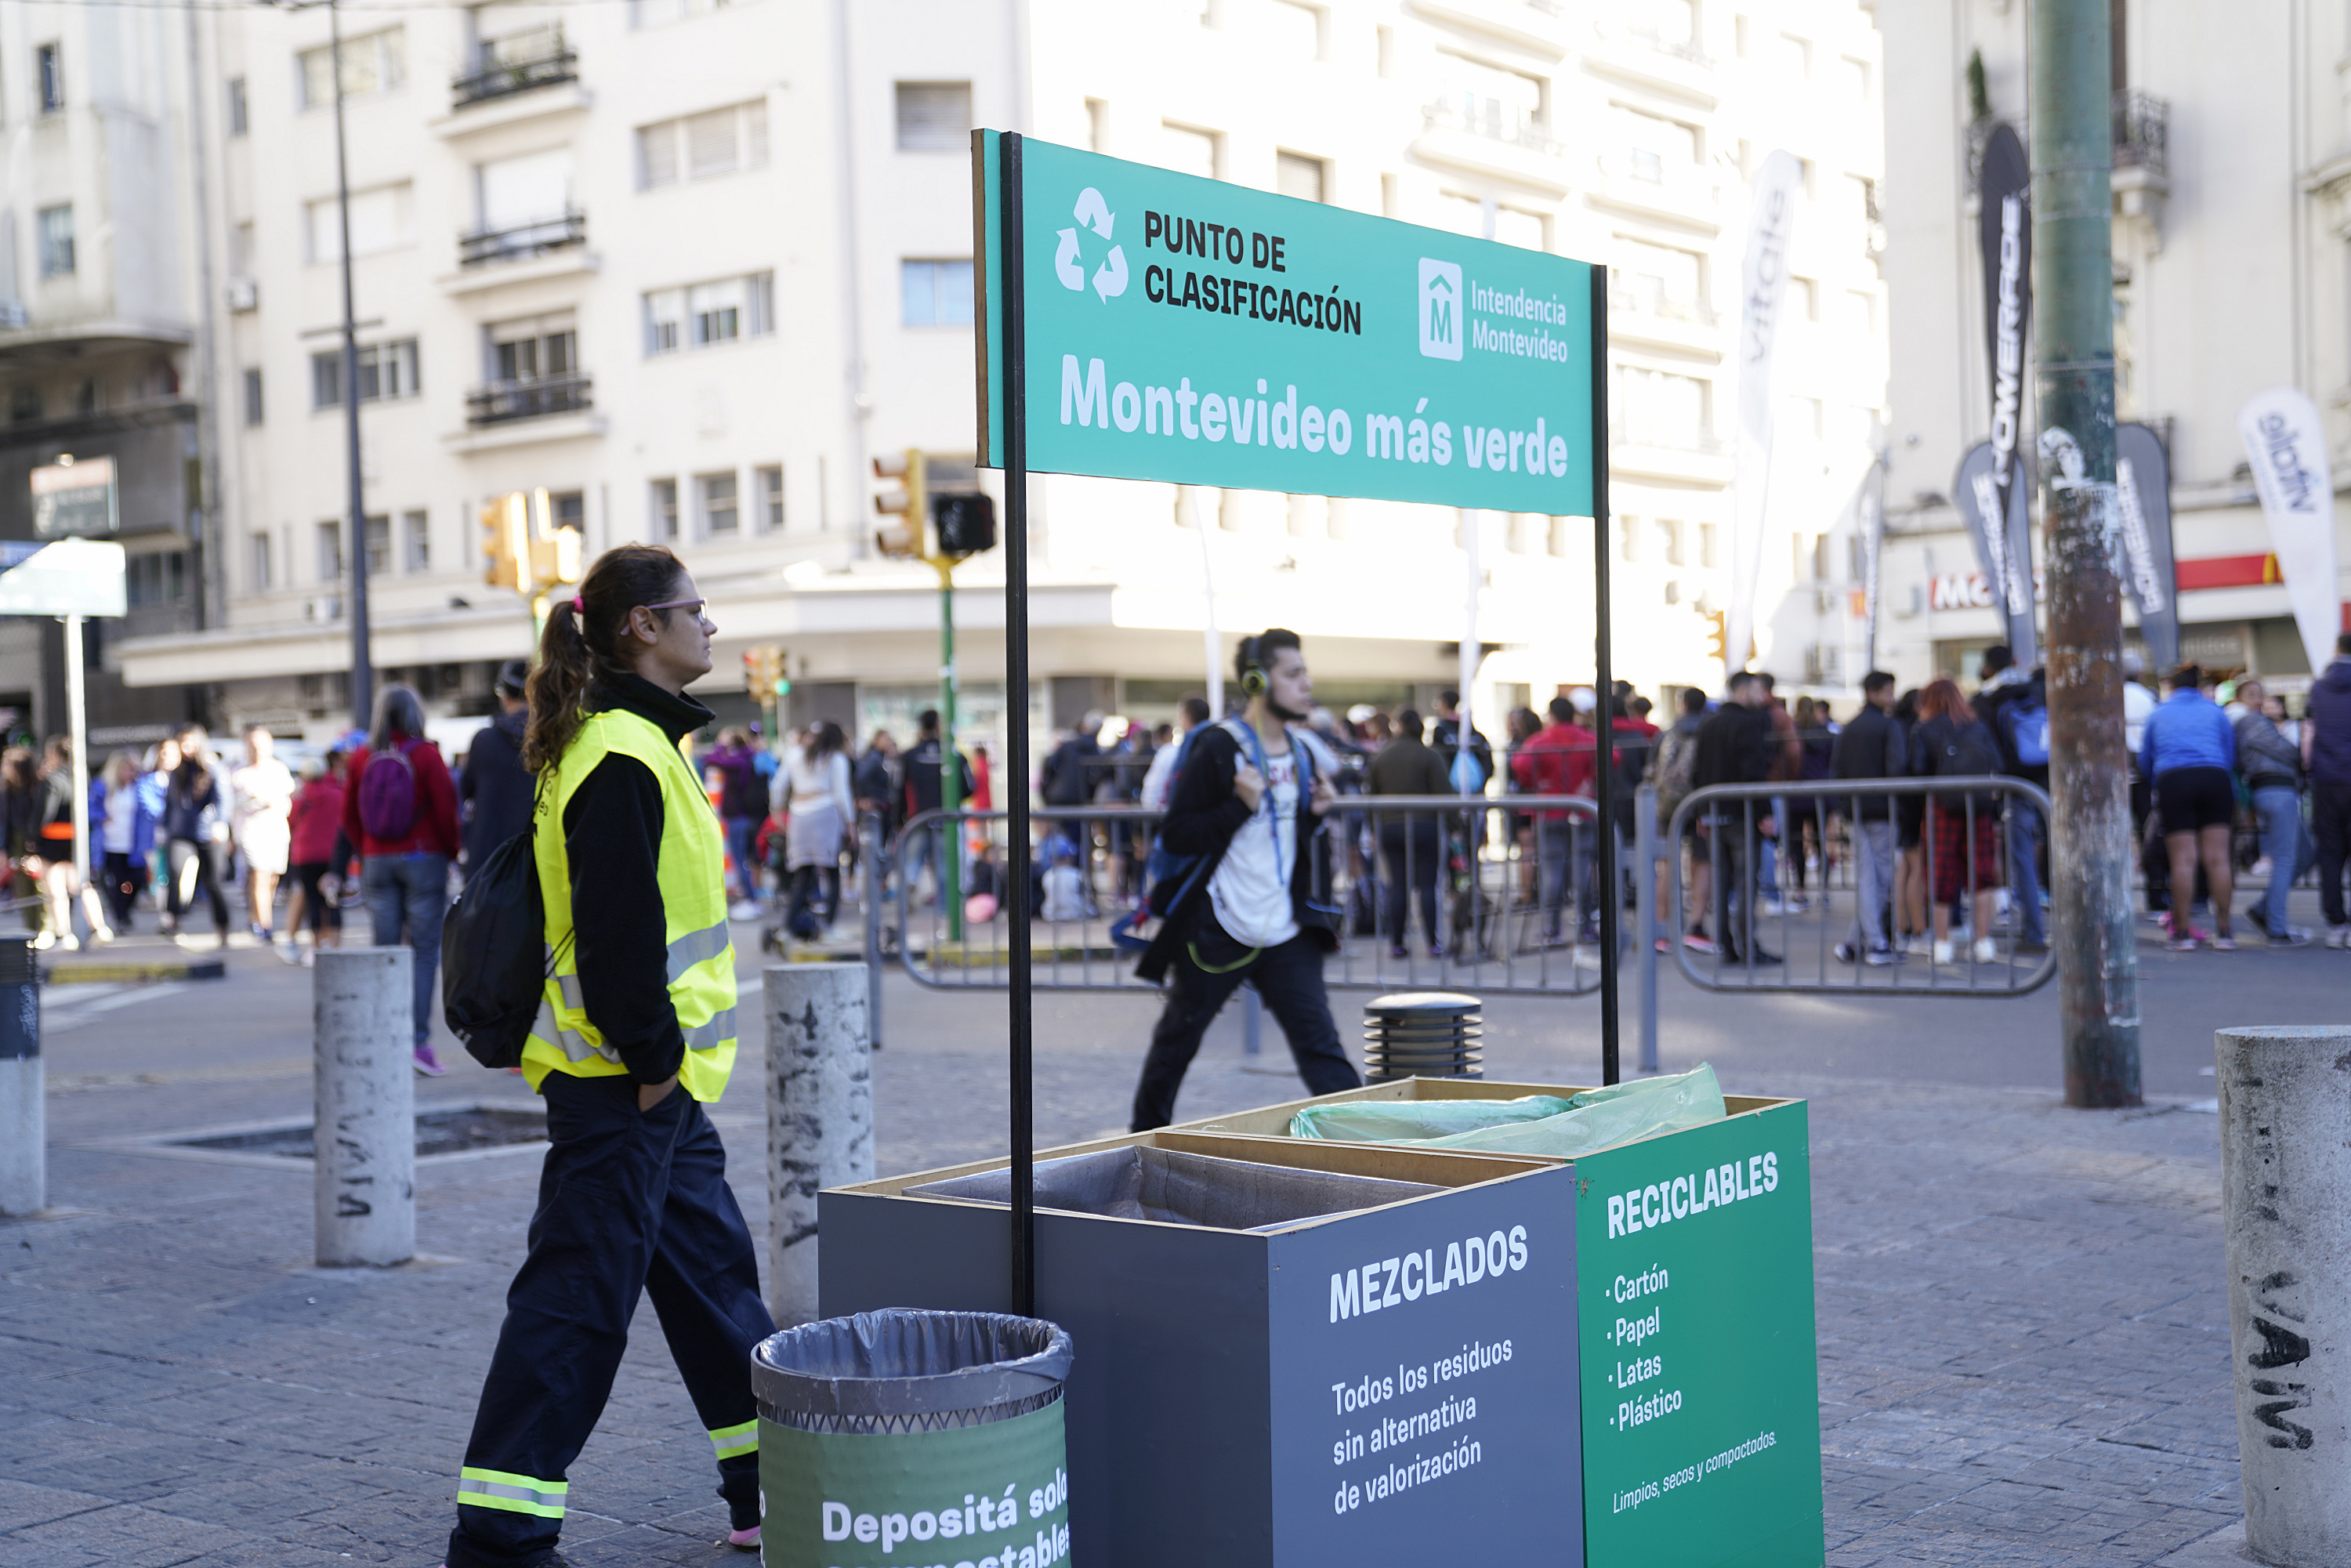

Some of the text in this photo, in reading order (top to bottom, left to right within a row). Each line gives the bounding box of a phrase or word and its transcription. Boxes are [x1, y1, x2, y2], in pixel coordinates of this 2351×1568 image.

[1145, 211, 1286, 273] PUNTO DE
[1145, 265, 1361, 335] CLASIFICACIÓN
[1472, 280, 1567, 326] Intendencia
[1473, 320, 1568, 364] Montevideo
[1060, 354, 1568, 478] Montevideo más verde
[1607, 1151, 1778, 1240] RECICLABLES
[1330, 1225, 1528, 1324] MEZCLADOS
[1614, 1263, 1668, 1304] Cartón
[1615, 1306, 1660, 1347] Papel
[1331, 1338, 1512, 1415] Todos los residuos
[1617, 1355, 1662, 1389] Latas
[1333, 1392, 1476, 1465] sin alternativa
[1618, 1388, 1682, 1432] Plástico
[1335, 1435, 1481, 1515] de valorización
[1613, 1431, 1777, 1514] Limpios, secos y compactados.
[822, 1483, 1017, 1554] Depositá
[1029, 1467, 1067, 1519] solo
